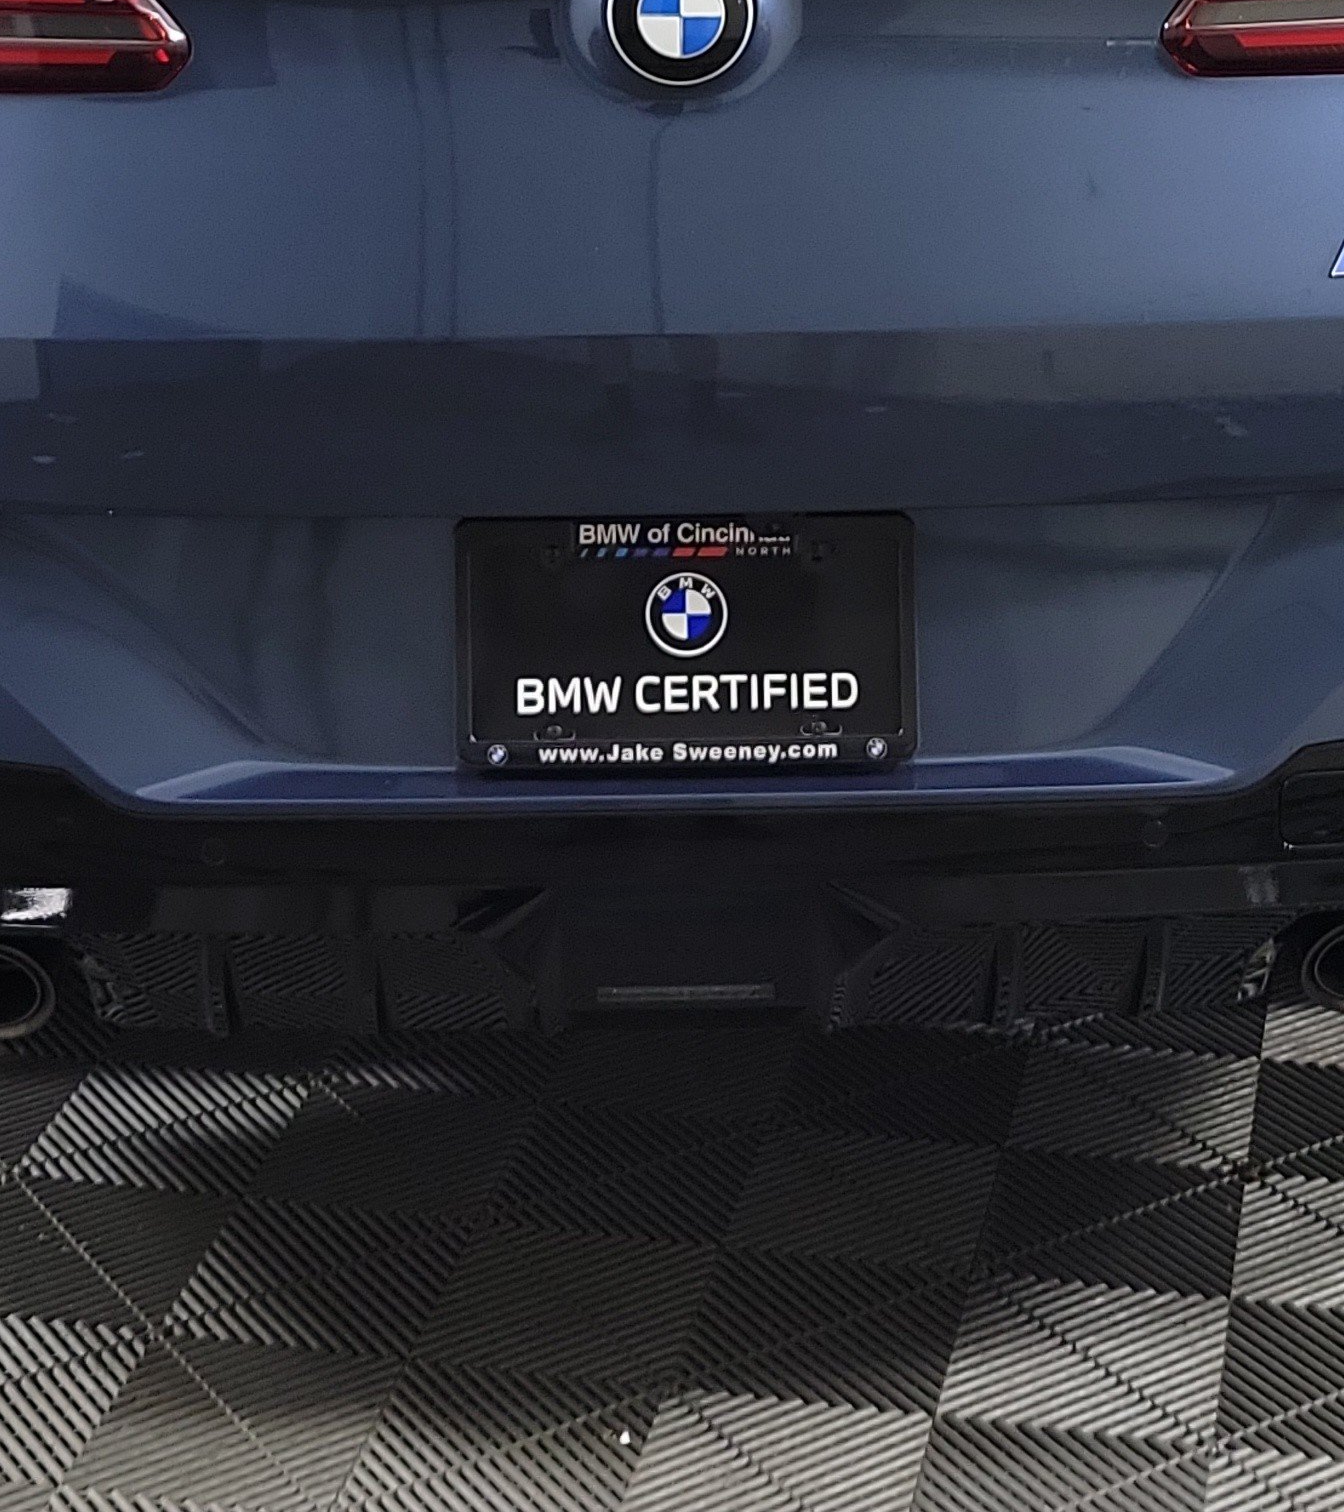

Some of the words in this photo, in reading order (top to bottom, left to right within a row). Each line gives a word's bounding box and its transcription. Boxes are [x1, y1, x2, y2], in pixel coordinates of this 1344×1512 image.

[579, 524, 641, 545] BMW
[647, 523, 671, 544] of
[677, 522, 791, 544] Cincin
[736, 546, 791, 556] NORTH
[657, 577, 716, 601] BMW
[516, 676, 622, 715] BMW
[635, 672, 859, 713] CERTIFIED
[538, 743, 664, 763] www.Jake
[672, 742, 838, 764] Sweeney.com
